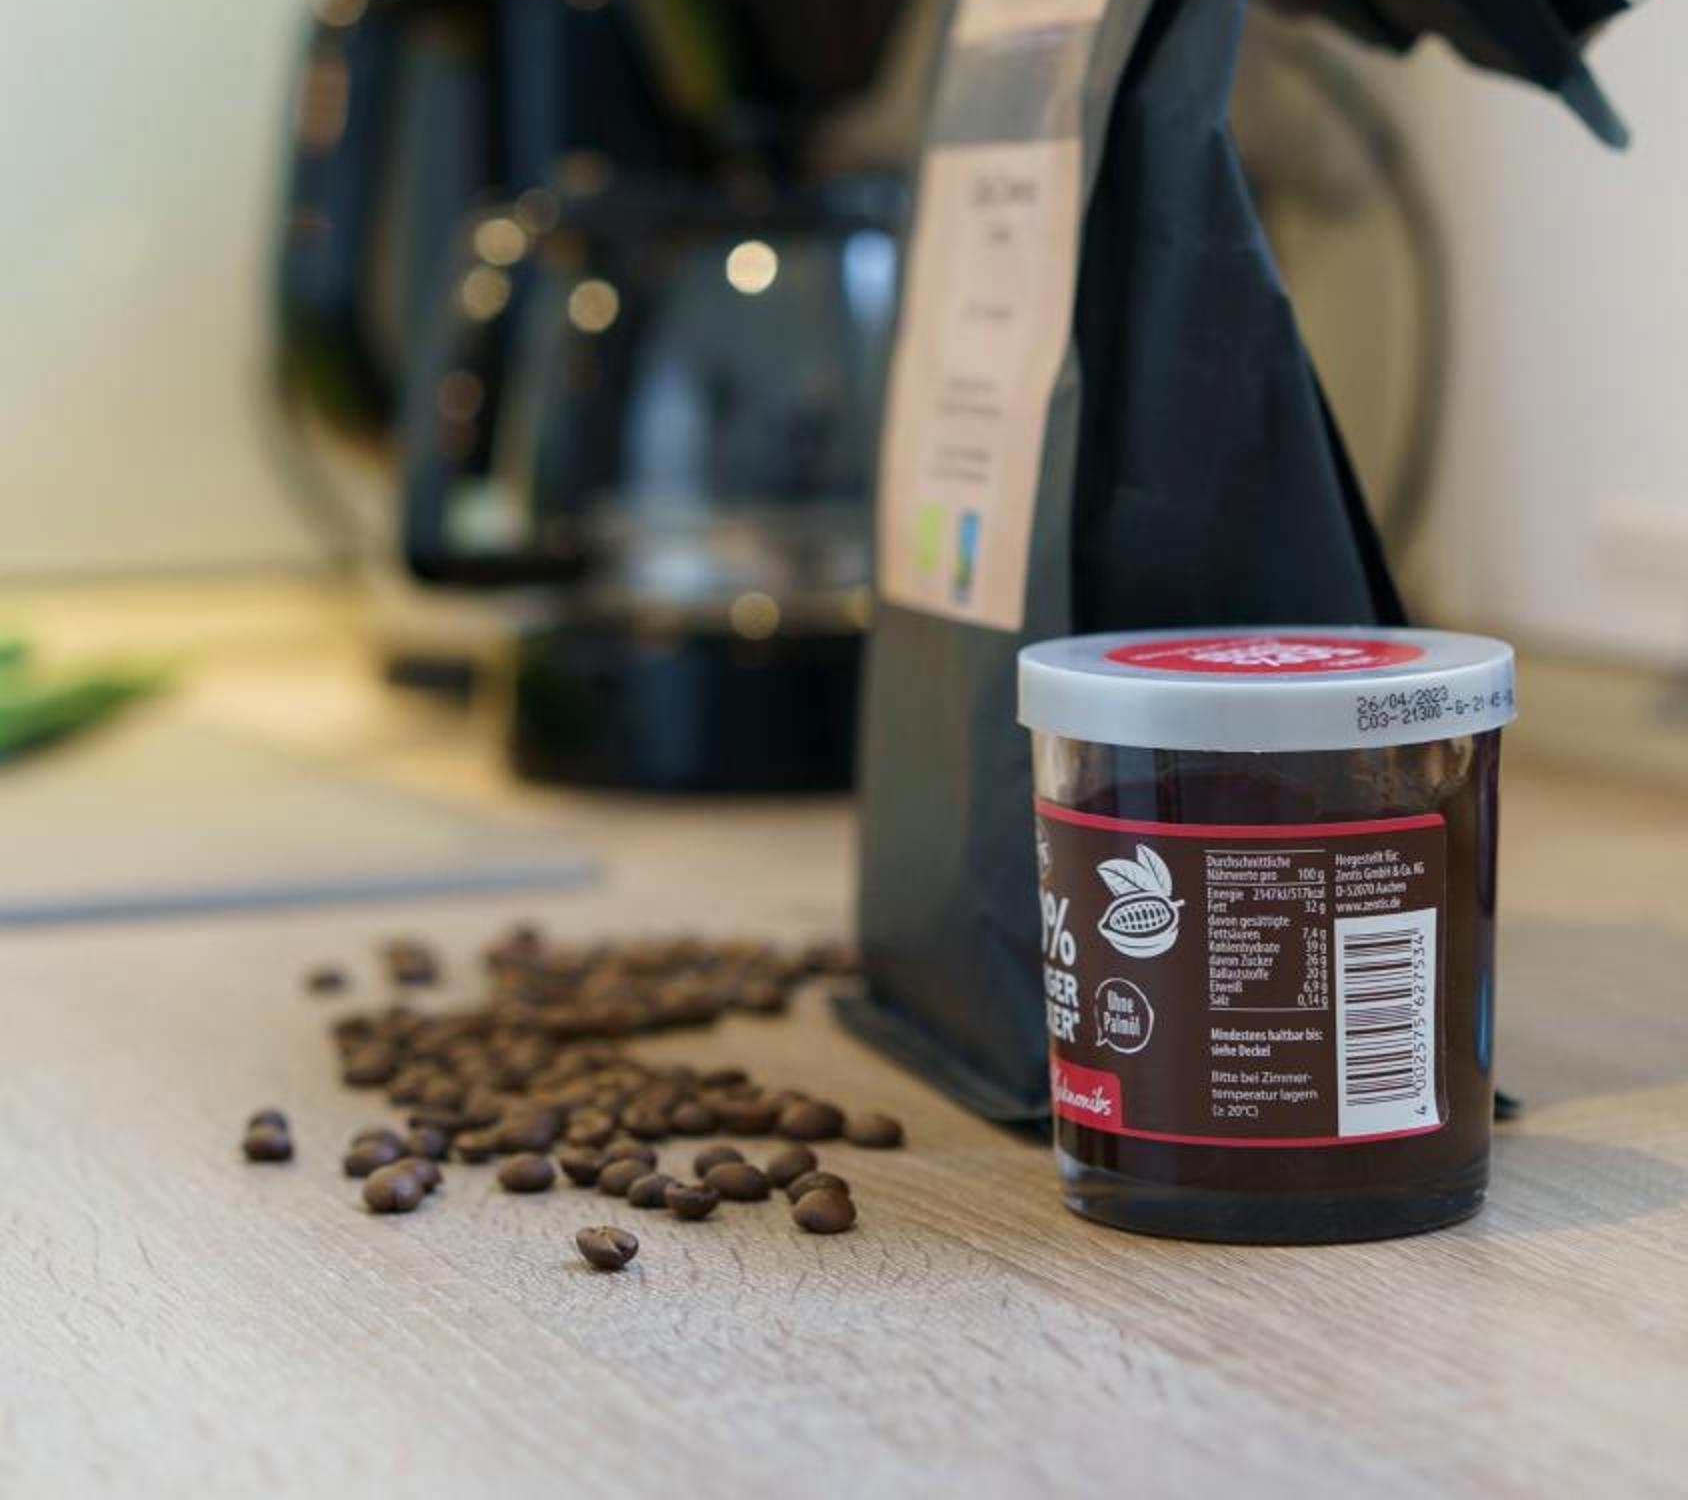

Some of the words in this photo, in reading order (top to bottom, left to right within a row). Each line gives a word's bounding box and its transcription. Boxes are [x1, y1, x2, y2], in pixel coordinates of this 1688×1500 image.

[1357, 684, 1449, 715] 26/04/2023
[1206, 855, 1291, 869] Durchschnittliche
[1335, 852, 1383, 868] Hergestellt
[1207, 868, 1259, 881] Nährwerte
[1298, 868, 1317, 881] 100
[1363, 865, 1391, 880] GmbH
[1207, 887, 1245, 903] Energie
[1376, 881, 1407, 895] Aachen
[1208, 900, 1227, 913] Fett
[1335, 896, 1400, 913] www.zentis.de
[1209, 940, 1280, 954] Kohlenhydrate
[1210, 967, 1269, 980] Ballaststoffe
[1107, 989, 1134, 1013] Ohne
[1210, 993, 1229, 1006] Salz
[1104, 1011, 1140, 1037] Palmöl
[1211, 1028, 1266, 1041] Mindestens
[1267, 1028, 1304, 1041] haltbar
[1238, 1043, 1270, 1057] Deckel
[1211, 1070, 1239, 1083] Bitte
[1240, 1071, 1259, 1084] bei
[1212, 1088, 1279, 1102] temperatur
[1280, 1088, 1319, 1103] lagern
